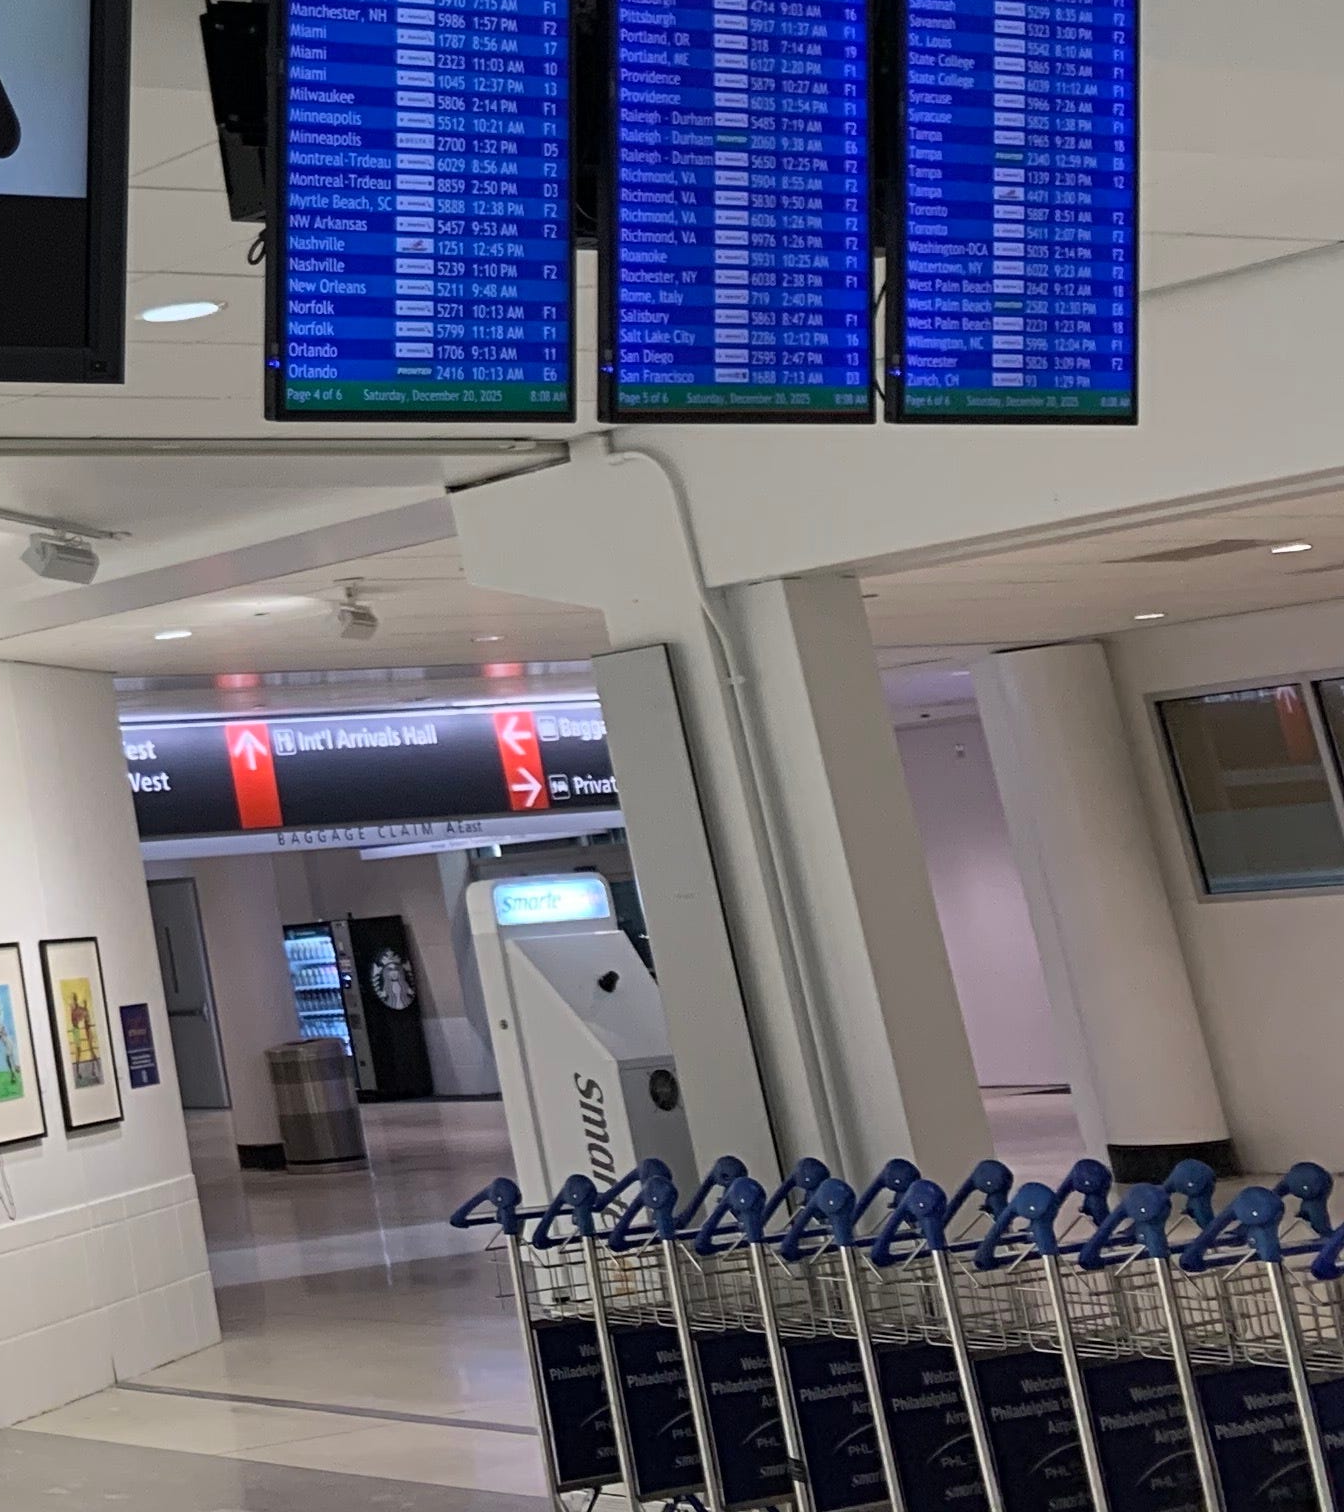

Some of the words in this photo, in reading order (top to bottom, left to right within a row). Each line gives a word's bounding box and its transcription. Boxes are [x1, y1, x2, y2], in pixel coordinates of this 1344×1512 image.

[290, 214, 310, 228] NW
[314, 216, 367, 231] Arkansas
[437, 220, 465, 234] 5457
[472, 221, 497, 236] 9:53
[500, 223, 518, 236] AM
[544, 224, 557, 238] F2
[337, 726, 400, 749] Arrivals
[404, 724, 438, 745] Hall
[122, 740, 157, 760] est
[277, 829, 366, 846] BAGGAGE
[377, 822, 433, 839] CLAIM
[549, 1363, 602, 1381] Philadelph
